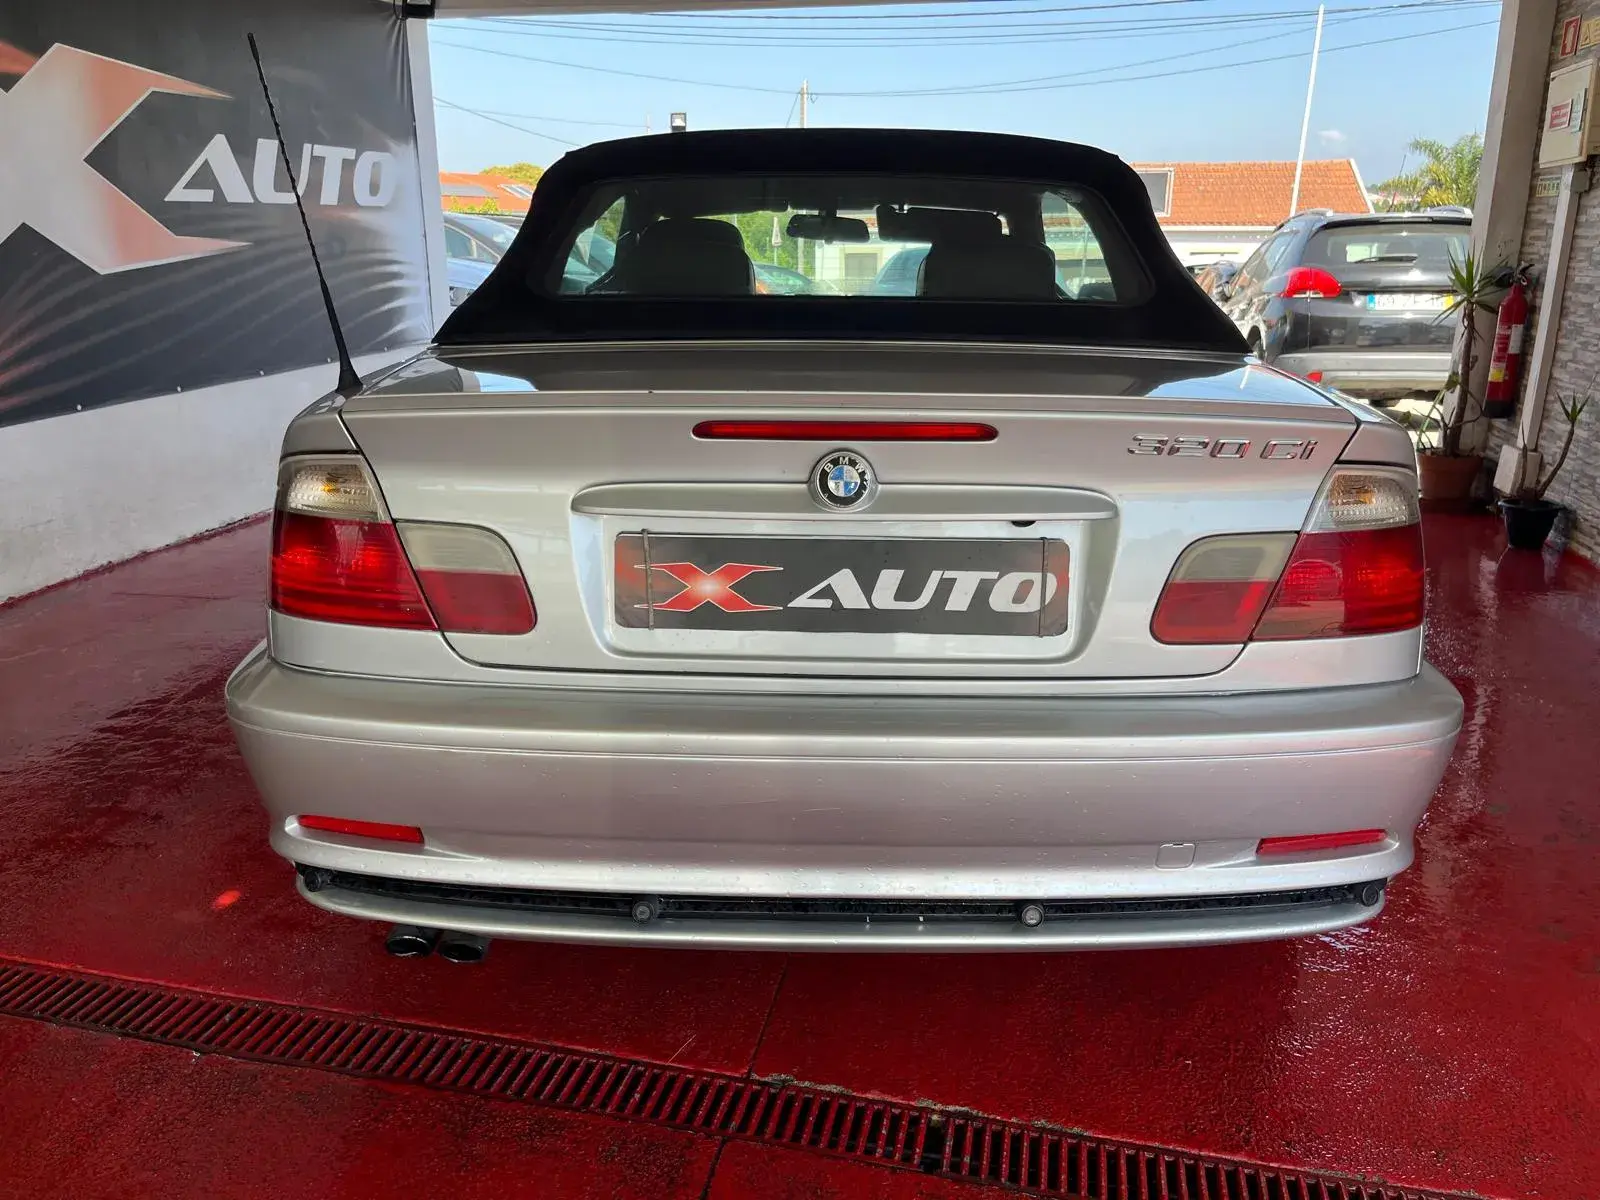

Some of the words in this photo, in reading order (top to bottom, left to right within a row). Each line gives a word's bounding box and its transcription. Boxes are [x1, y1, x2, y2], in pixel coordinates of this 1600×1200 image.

[164, 133, 397, 207] AUTO
[824, 456, 865, 473] BMW
[1127, 433, 1251, 459] 320
[1259, 438, 1319, 460] Ci
[634, 562, 783, 613] X
[787, 568, 1057, 613] AUTO
